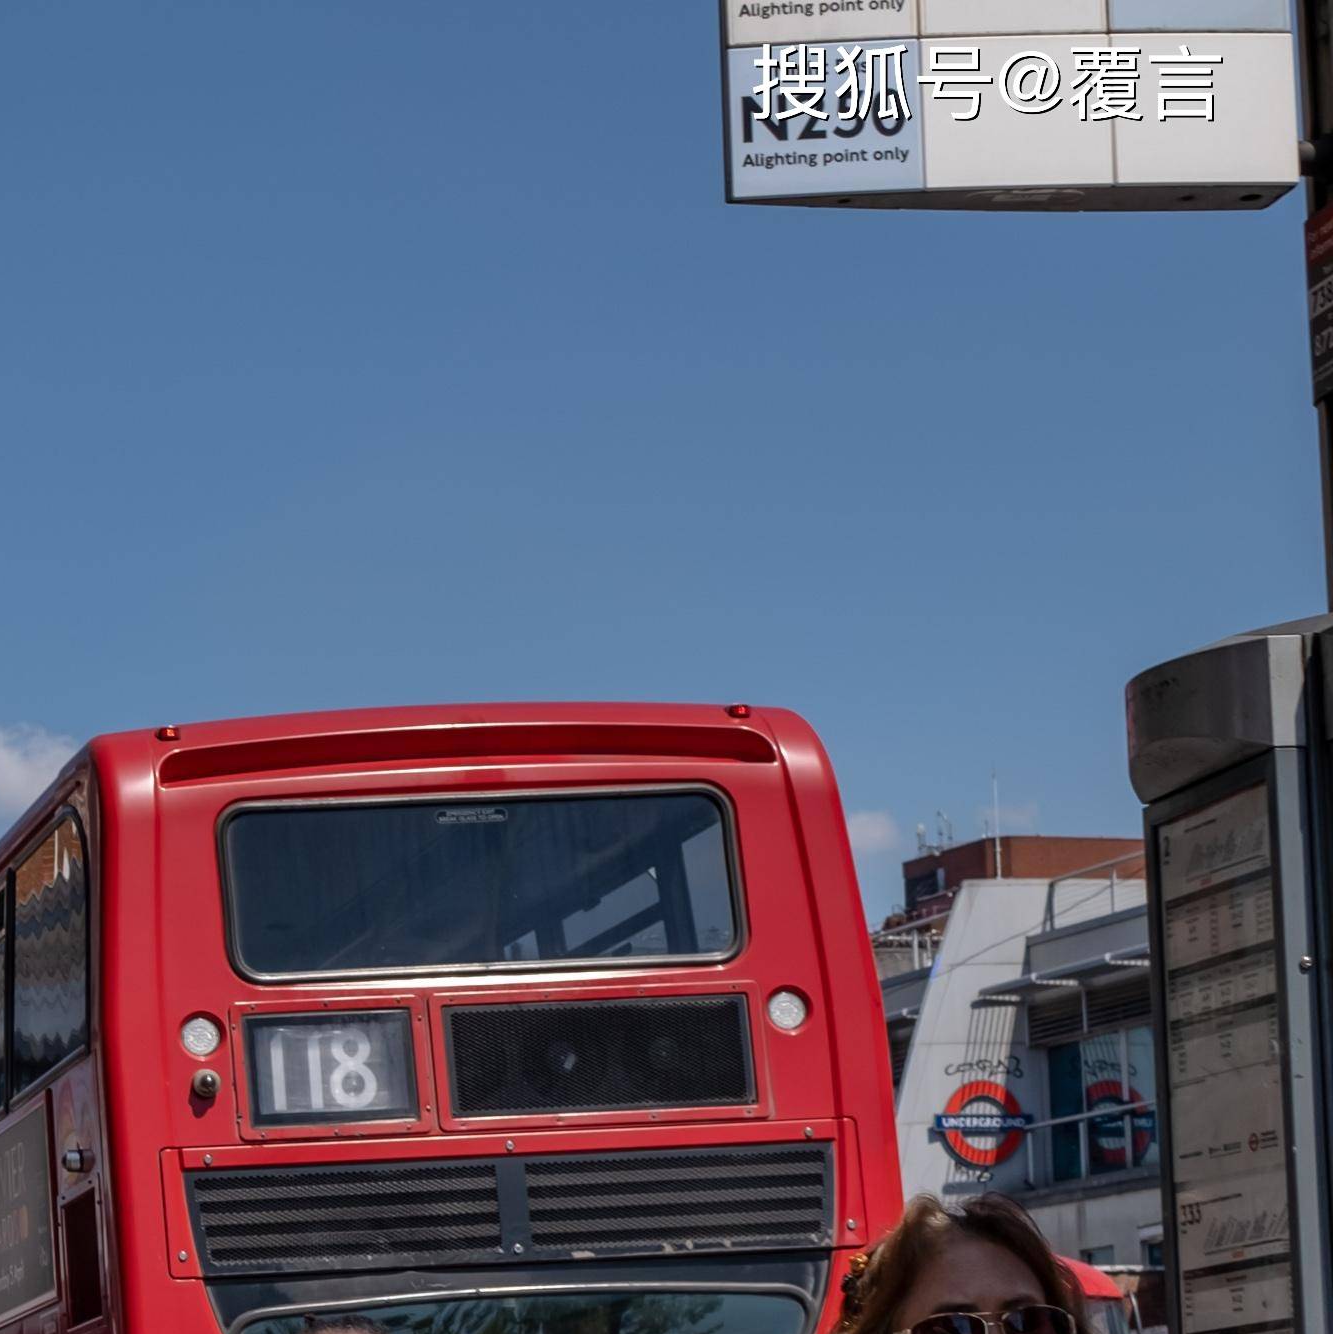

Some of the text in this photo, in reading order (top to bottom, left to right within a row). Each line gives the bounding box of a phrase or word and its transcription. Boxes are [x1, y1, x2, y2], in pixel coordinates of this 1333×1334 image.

[742, 147, 910, 169] Alighting point only
[270, 1028, 378, 1111] 118
[941, 1115, 1026, 1128] UNDERGROUND
